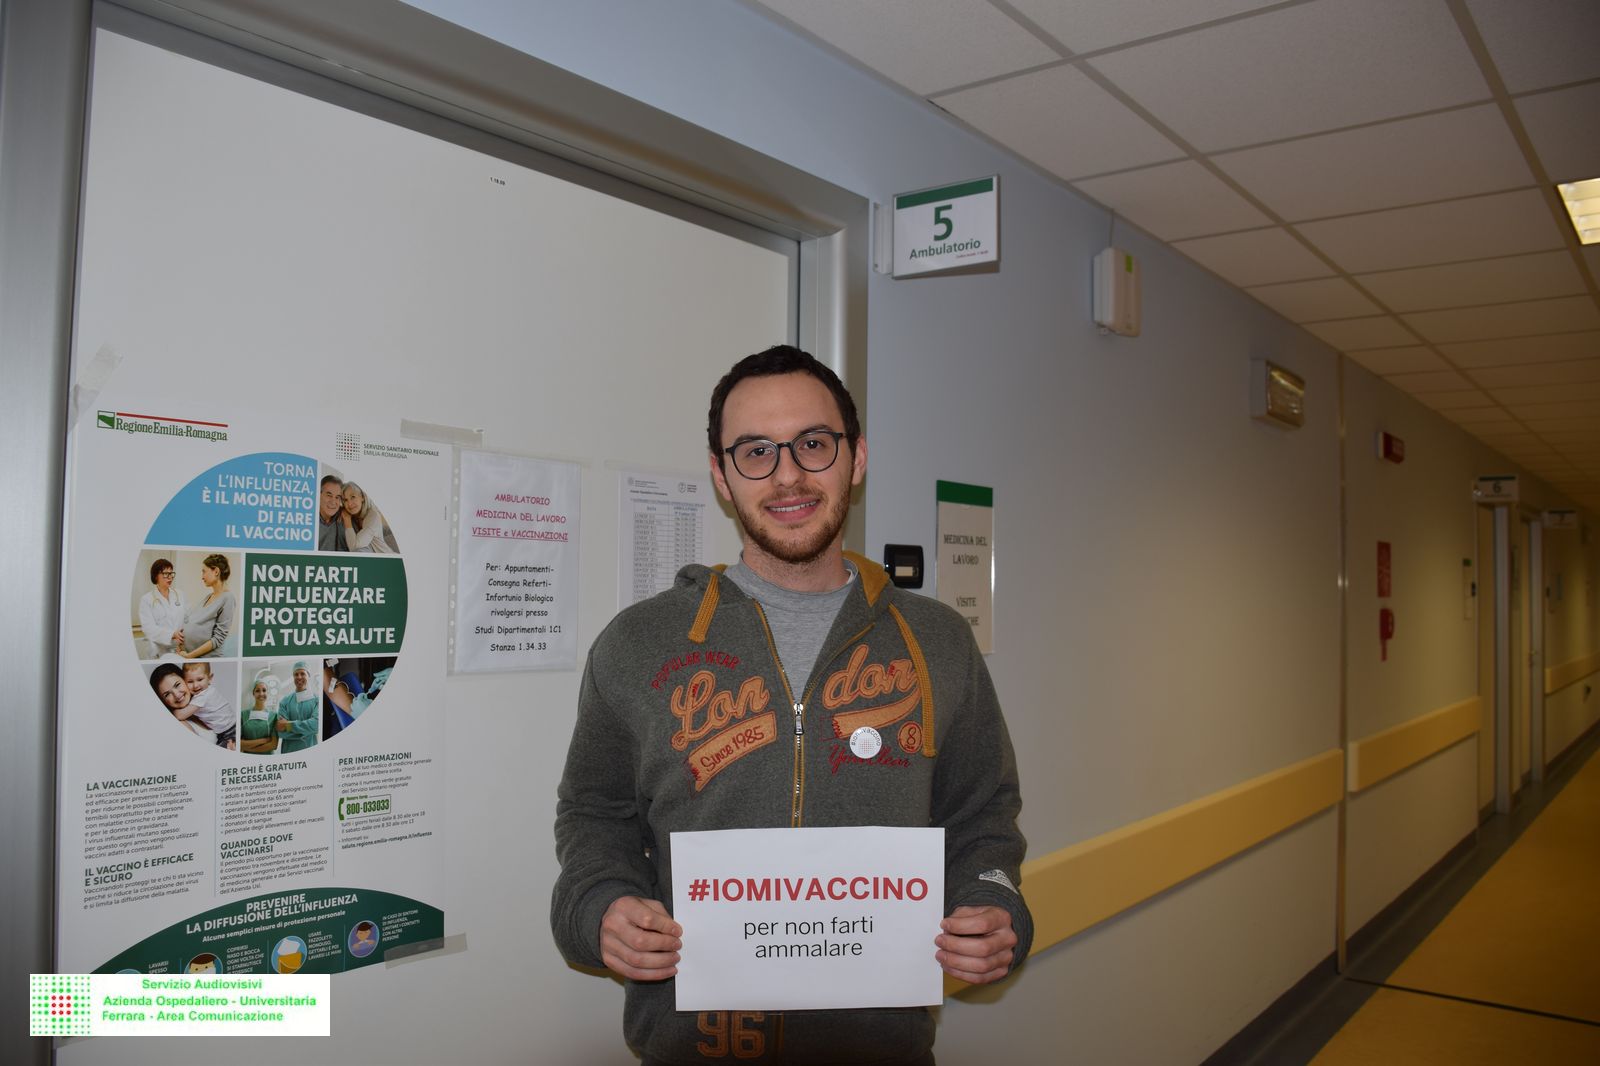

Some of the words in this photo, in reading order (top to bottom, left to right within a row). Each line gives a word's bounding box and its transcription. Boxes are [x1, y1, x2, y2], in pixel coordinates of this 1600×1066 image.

[934, 204, 953, 241] 5
[909, 238, 981, 260] Ambulatorio
[413, 448, 439, 456] REGIONALE
[264, 462, 315, 478] TORNA
[218, 474, 314, 495] L'INFLUENZA,
[1493, 481, 1502, 493] 6
[202, 486, 211, 503] È
[215, 491, 229, 504] IL
[233, 492, 313, 510] MOMENTO
[494, 493, 550, 506] AMBULATORIO
[258, 510, 273, 524] DI
[278, 511, 312, 526] FARE
[476, 509, 516, 521] MEDICINA
[519, 512, 533, 522] DEL
[536, 513, 566, 524] LAVORO
[226, 525, 240, 538] IL
[243, 526, 312, 541] VACCINO
[472, 527, 500, 535] VISITE
[511, 529, 568, 539] VACCINAZIONI
[944, 534, 974, 546] MEDICINA
[976, 536, 987, 546] DEL
[486, 563, 500, 572] Per:
[953, 555, 979, 565] LAVORO
[252, 565, 298, 583] NON
[305, 566, 358, 584] FARTI
[488, 578, 520, 590] Consegna
[252, 586, 386, 604] INFLUENZARE
[486, 593, 521, 602] Infortunio
[524, 593, 553, 604] Biologico
[956, 597, 976, 607] VISITE
[251, 607, 353, 625] PROTEGGI
[491, 608, 523, 618] rivolgersi
[525, 610, 548, 618] presso
[250, 629, 276, 646] LA
[280, 628, 320, 646] TUA
[325, 627, 395, 645] SALUTE
[475, 625, 494, 634] Studi
[497, 623, 546, 635] Dipartimentali
[490, 643, 515, 651] Stanza
[519, 642, 547, 650] 1.34.33
[652, 651, 700, 690] POPULAR
[706, 651, 740, 670] WEAR
[906, 727, 916, 745] 8
[700, 745, 733, 772] Since
[732, 726, 764, 749] 1985
[86, 782, 98, 791] LA
[102, 775, 177, 790] VACCINAZIONE
[85, 867, 94, 877] IL
[96, 860, 141, 875] VACCINO
[143, 860, 148, 869] È
[151, 853, 194, 868] EFFICACE
[85, 877, 90, 886] E
[93, 872, 132, 885] SICURO
[688, 877, 928, 902] #IOMIVACCINO
[246, 893, 306, 912] PREVENIRE
[186, 921, 201, 934] LA
[204, 909, 270, 931] DIFFUSIONE
[274, 894, 358, 918] DELL'INFLUENZA
[202, 932, 225, 943] Alcune
[226, 927, 253, 938] semplici
[254, 923, 275, 933] misure
[276, 921, 282, 929] di
[283, 915, 316, 928] protezione
[317, 910, 346, 922] personale
[744, 921, 778, 939] per
[785, 920, 824, 935] non
[831, 916, 873, 934] farti
[755, 940, 862, 958] ammalare
[697, 1011, 764, 1058] 96
